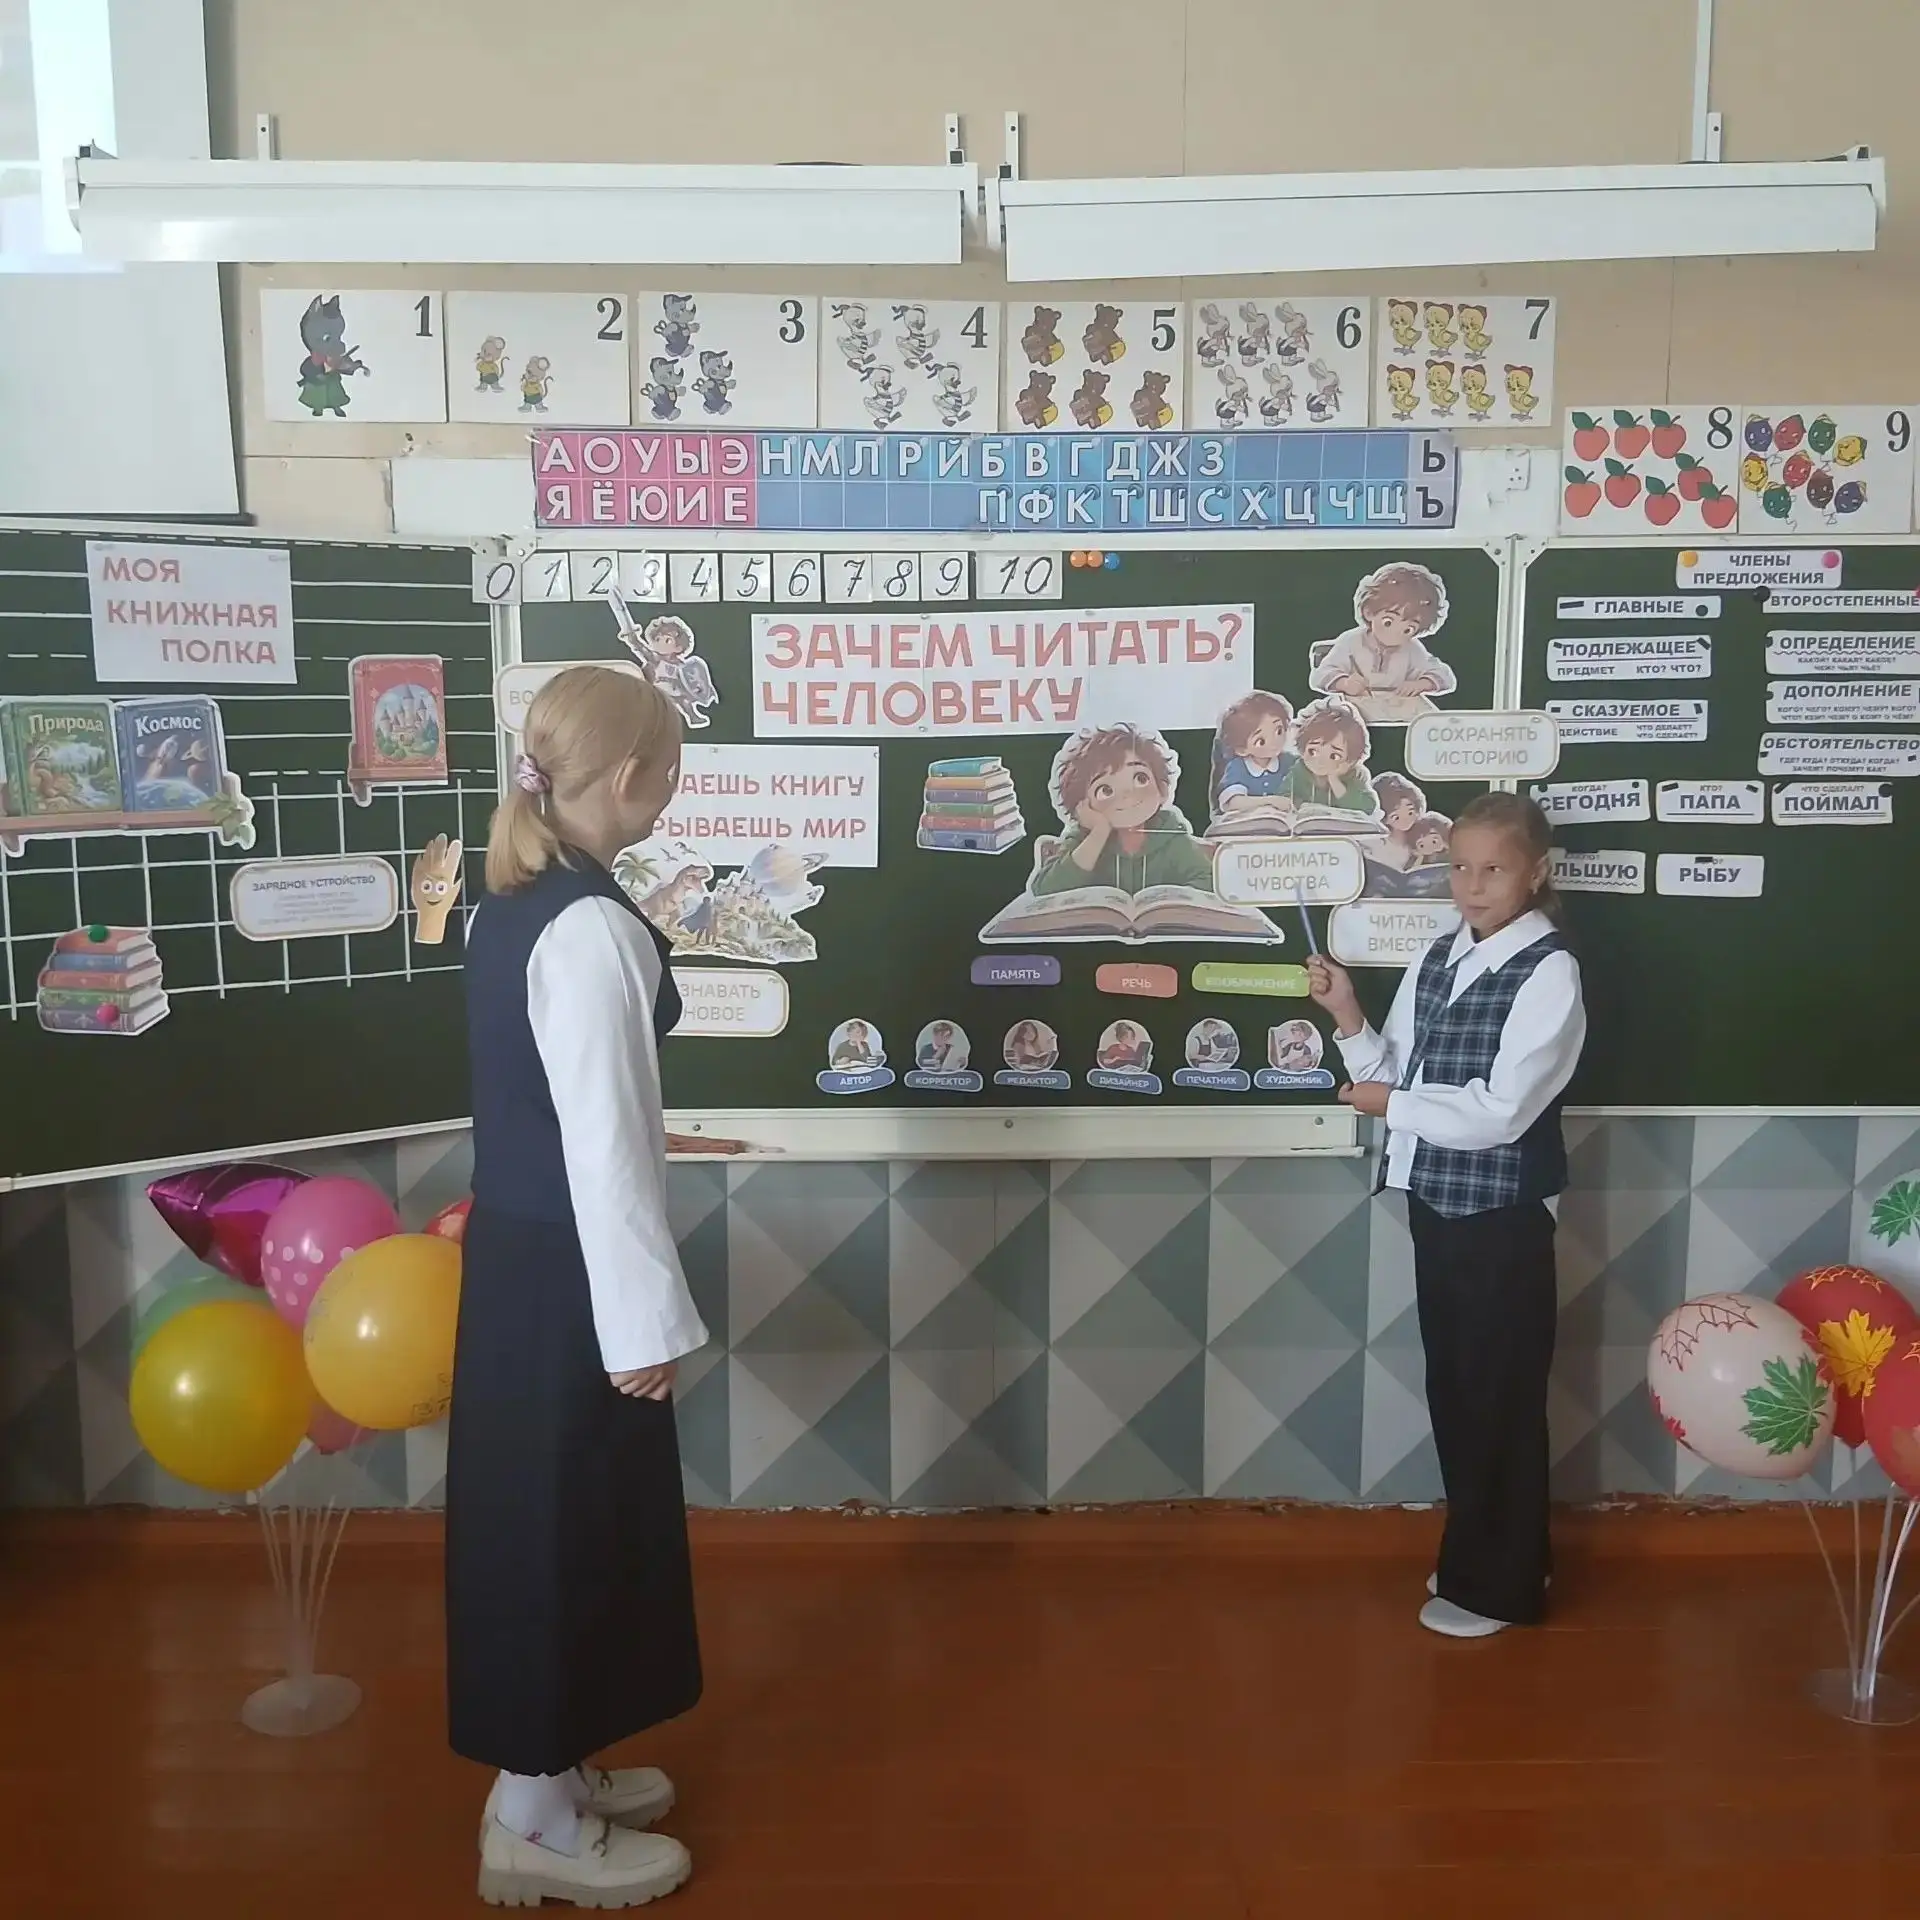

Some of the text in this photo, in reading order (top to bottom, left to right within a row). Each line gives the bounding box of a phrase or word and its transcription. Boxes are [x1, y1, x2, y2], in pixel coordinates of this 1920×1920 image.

[415, 296, 433, 337] 1
[597, 297, 624, 341] 2
[779, 300, 805, 343] 3
[1525, 300, 1549, 340] 7
[961, 306, 988, 349] 4
[1151, 307, 1177, 351] 5
[1337, 307, 1362, 349] 6
[1706, 407, 1733, 449] 8
[1885, 410, 1911, 452] 9
[541, 434, 1447, 480] А О У Ы Э Н М Л Р Й Б В Г Д Ж З Ь
[545, 480, 1443, 529] Я Ё Ю И Е П Ф К Т Ш С Х Ц Ч Щ Ъ
[1729, 554, 1791, 567] ЧЛЕНЫ
[103, 557, 180, 583] МОЯ
[486, 557, 1052, 599] 0 1 2 3 4 5 6 7 8 9 10
[1693, 571, 1824, 586] ПРЕДЛОЖЕНИЯ
[1594, 600, 1684, 614] ГЛАВНЫЕ
[1771, 594, 1920, 607] ВТОРОСТЕПЕННЫЕ
[107, 600, 278, 629] КНИЖНАЯ
[765, 613, 1242, 670] ЗАЧЕМ ЧИТАТЬ?
[1562, 641, 1696, 658] ПОДЛЕЖАЩЕЕ
[1780, 636, 1916, 651] ОПРЕДЕЛЕНИЕ
[161, 639, 276, 665] ПОЛКА
[1557, 664, 1701, 676] ПРЕДМЕТ КТО? ЧТО?
[1783, 684, 1912, 700] ДОПОЛНЕНИЕ
[763, 676, 1083, 726] ЧЕЛОВЕКУ
[1572, 704, 1680, 716] СКАЗУЕМОЕ
[29, 713, 104, 735] Природа
[135, 715, 202, 738] Космос
[1559, 728, 1618, 737] ДЕЙСТВИЕ
[1427, 726, 1538, 742] СОХРАНЯТЬ
[1764, 737, 1920, 750] ОБСТОЯТЕЛЬСТВО
[1435, 749, 1530, 767] ИСТОРИЮ
[681, 774, 865, 796] АЕШЬ КНИГУ
[1538, 793, 1641, 811] СЕГОДНЯ
[1680, 795, 1741, 809] ПАПА
[1785, 793, 1879, 811] ПОЙМАЛ
[651, 816, 866, 838] РЫВАЕШЬ МИР
[1237, 852, 1340, 870] ПОНИМАТЬ
[1553, 862, 1638, 880] ЛЬШУЮ
[1680, 868, 1741, 883] РЫБУ
[252, 875, 376, 891] ЗАРЯДНОЕ УСТРОЙСТВО
[1247, 875, 1330, 892] ЧУВСТВА
[1369, 914, 1438, 930] ЧИТАТЬ
[991, 969, 1040, 980] ПАМЯТЬ
[1122, 978, 1151, 988] РЕЧЬ
[679, 984, 761, 1000] ЗНАВАТЬ
[684, 1006, 745, 1021] НОВОЕ
[840, 1075, 872, 1086] АВТОР
[915, 1077, 971, 1086] КОРРЕКТОР
[1007, 1077, 1057, 1086] РЕДАКТОР
[1100, 1075, 1149, 1088] ДИЗАЙНЕР
[1186, 1075, 1237, 1086] ПЕЧАТНИК
[1266, 1075, 1323, 1086] ХУДОЖНИК
